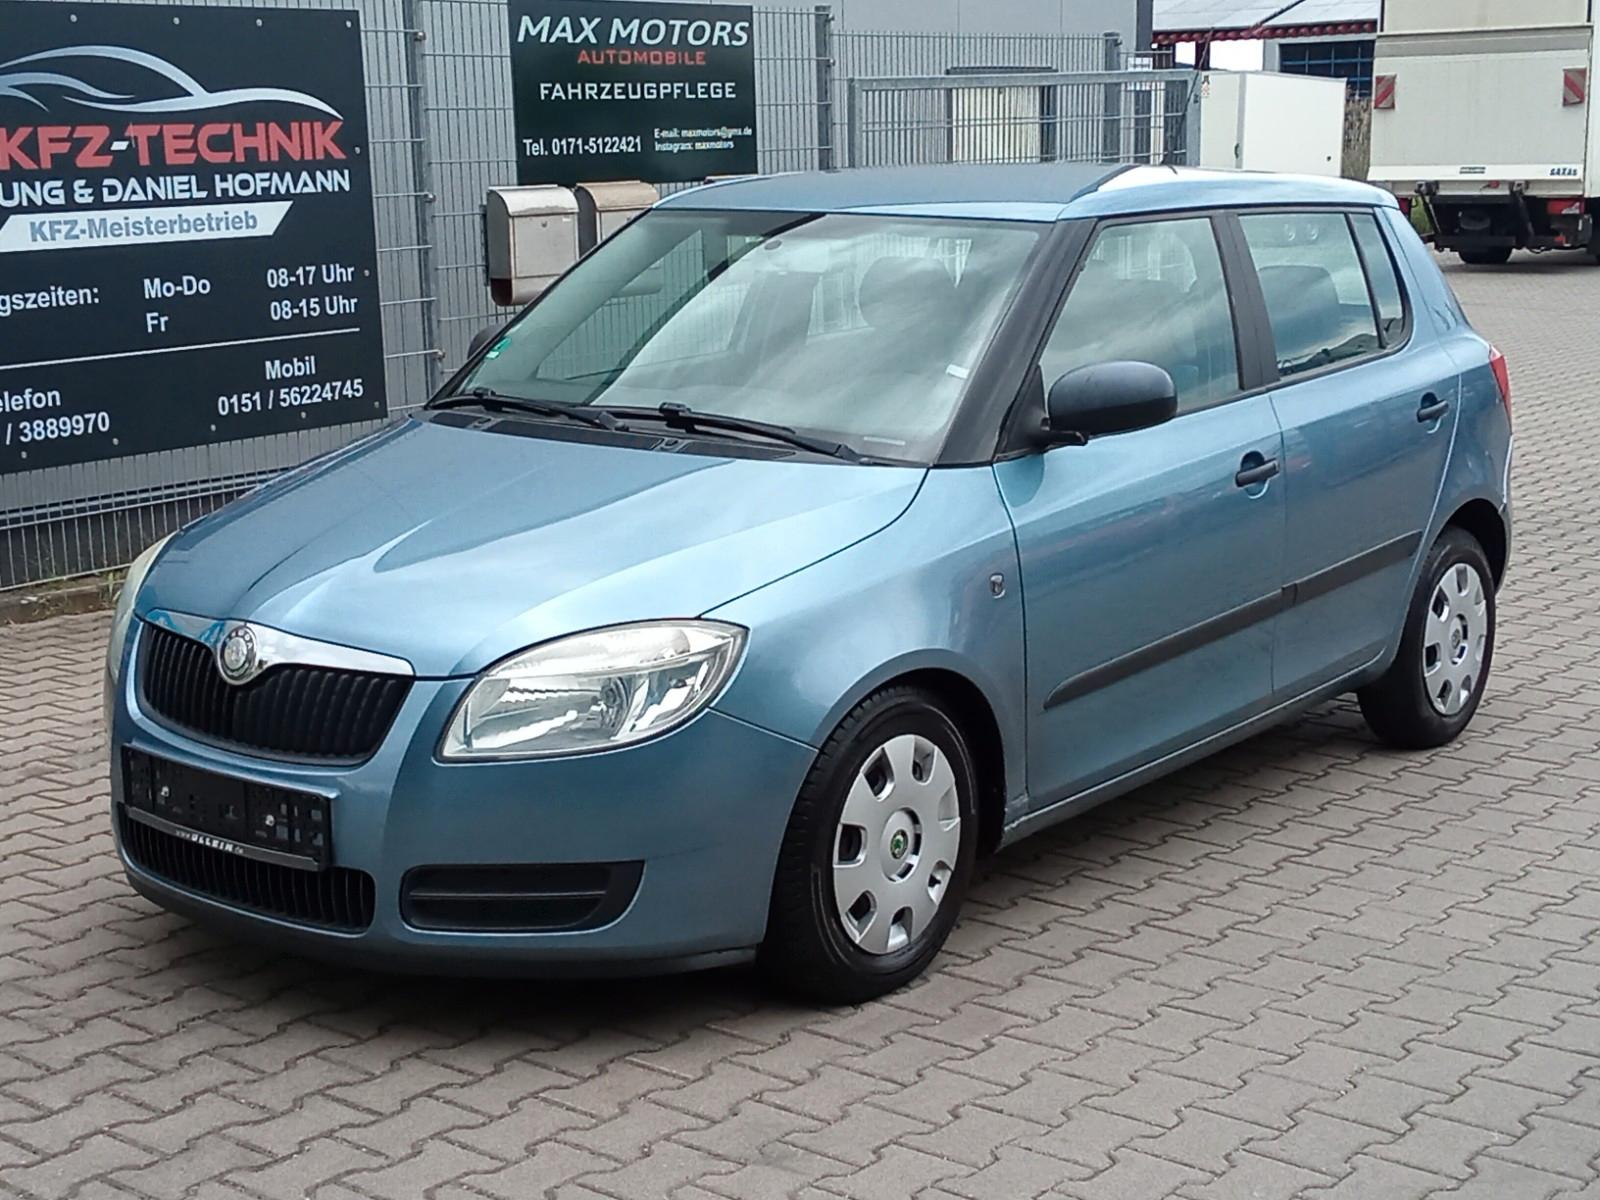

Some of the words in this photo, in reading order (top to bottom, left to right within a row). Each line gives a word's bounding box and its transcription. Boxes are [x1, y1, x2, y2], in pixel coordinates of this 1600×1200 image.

[517, 15, 601, 44] MAX
[608, 18, 749, 47] MOTORS
[577, 50, 706, 65] AUTOMOBILE
[540, 82, 736, 100] FAHRZEUGPFLEGE
[0, 121, 347, 170] KFZ-TECHNIK
[523, 139, 549, 156] Tel.
[551, 136, 641, 155] 0171-5122421
[73, 179, 95, 204] &
[102, 174, 208, 203] DANIEL
[214, 169, 350, 199] HOFMANN
[29, 211, 258, 243] KFZ-Meisterbetrieb
[267, 266, 316, 289] 08-17
[321, 263, 355, 284] Uhr
[0, 285, 100, 317] gszeiten:
[143, 275, 211, 299] Mo-Do
[270, 298, 321, 321] 08-15
[325, 295, 358, 316] Uhr
[146, 313, 169, 333] Fr
[265, 356, 316, 380] Mobil
[0, 388, 61, 413] lefon
[217, 395, 261, 416] 0151
[279, 379, 364, 408] 56224745
[19, 411, 110, 442] 3889970
